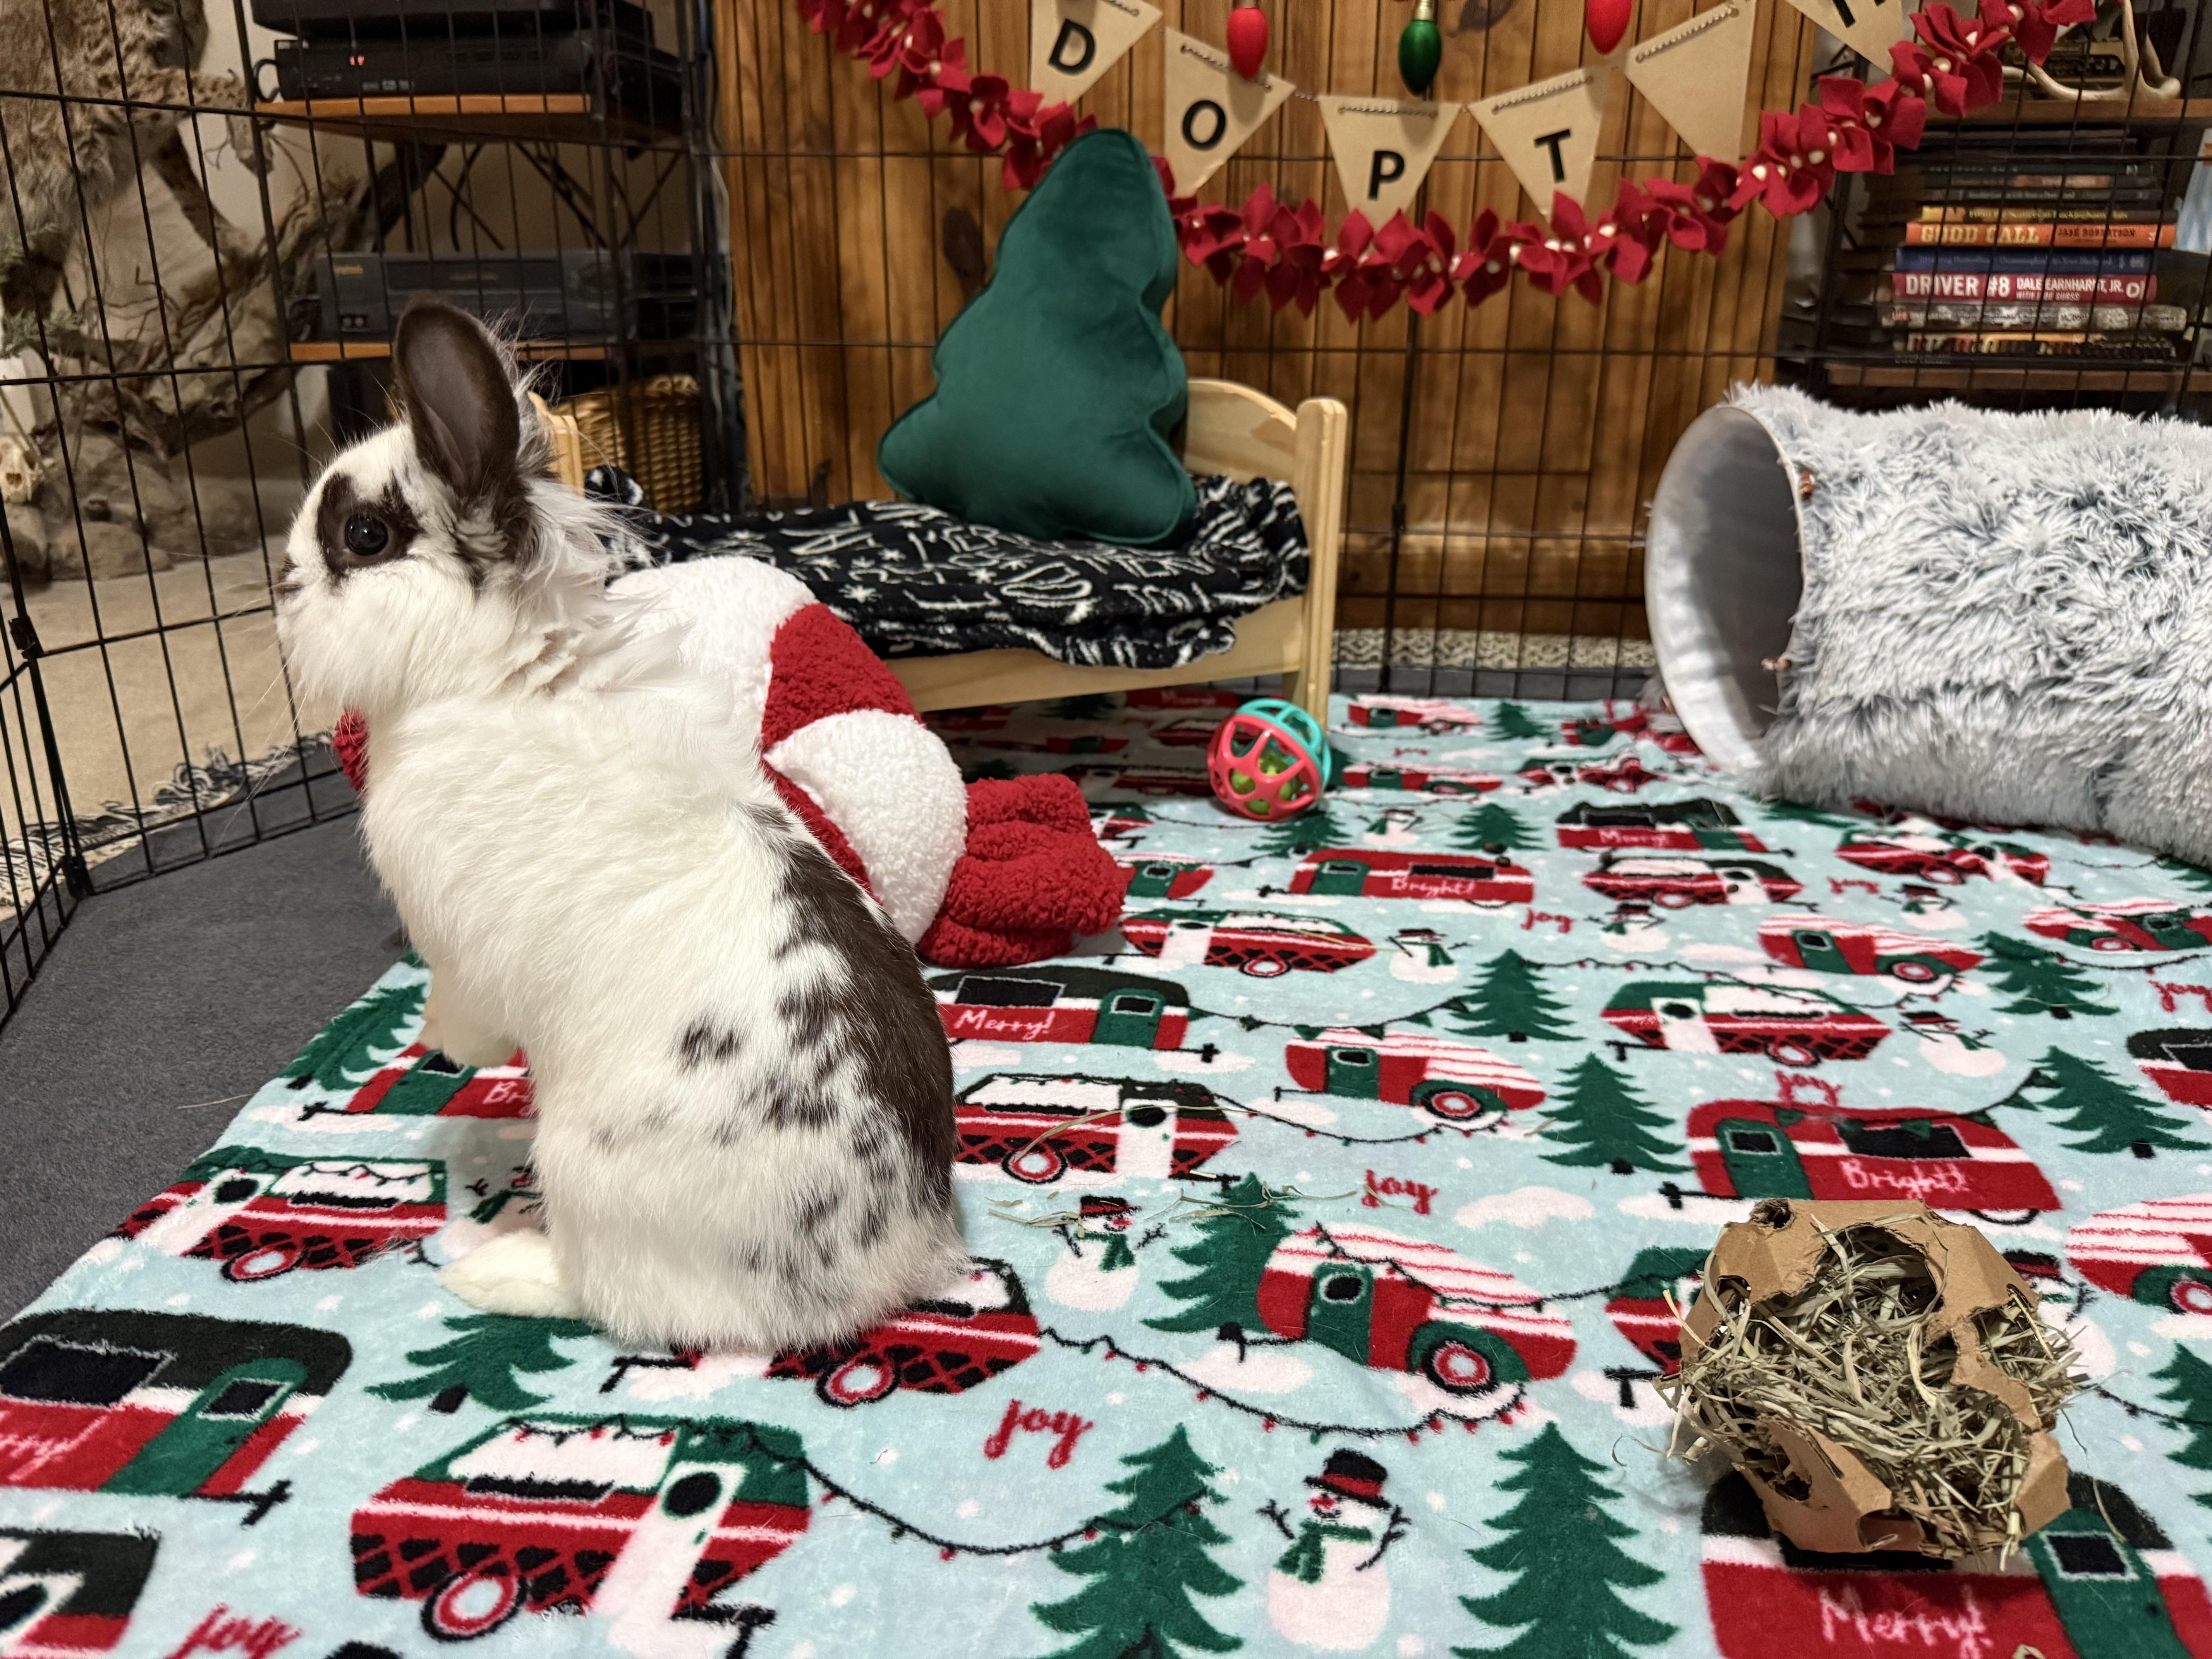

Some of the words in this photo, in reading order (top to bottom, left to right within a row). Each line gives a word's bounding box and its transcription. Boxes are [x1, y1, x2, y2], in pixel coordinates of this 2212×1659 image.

[1921, 226, 1978, 244] GOOD
[1986, 226, 2039, 244] CALL
[1906, 274, 1979, 296] DRIVER
[1987, 275, 2011, 297] #8
[2016, 277, 2043, 290] DALE
[954, 1009, 1056, 1041] Merry!
